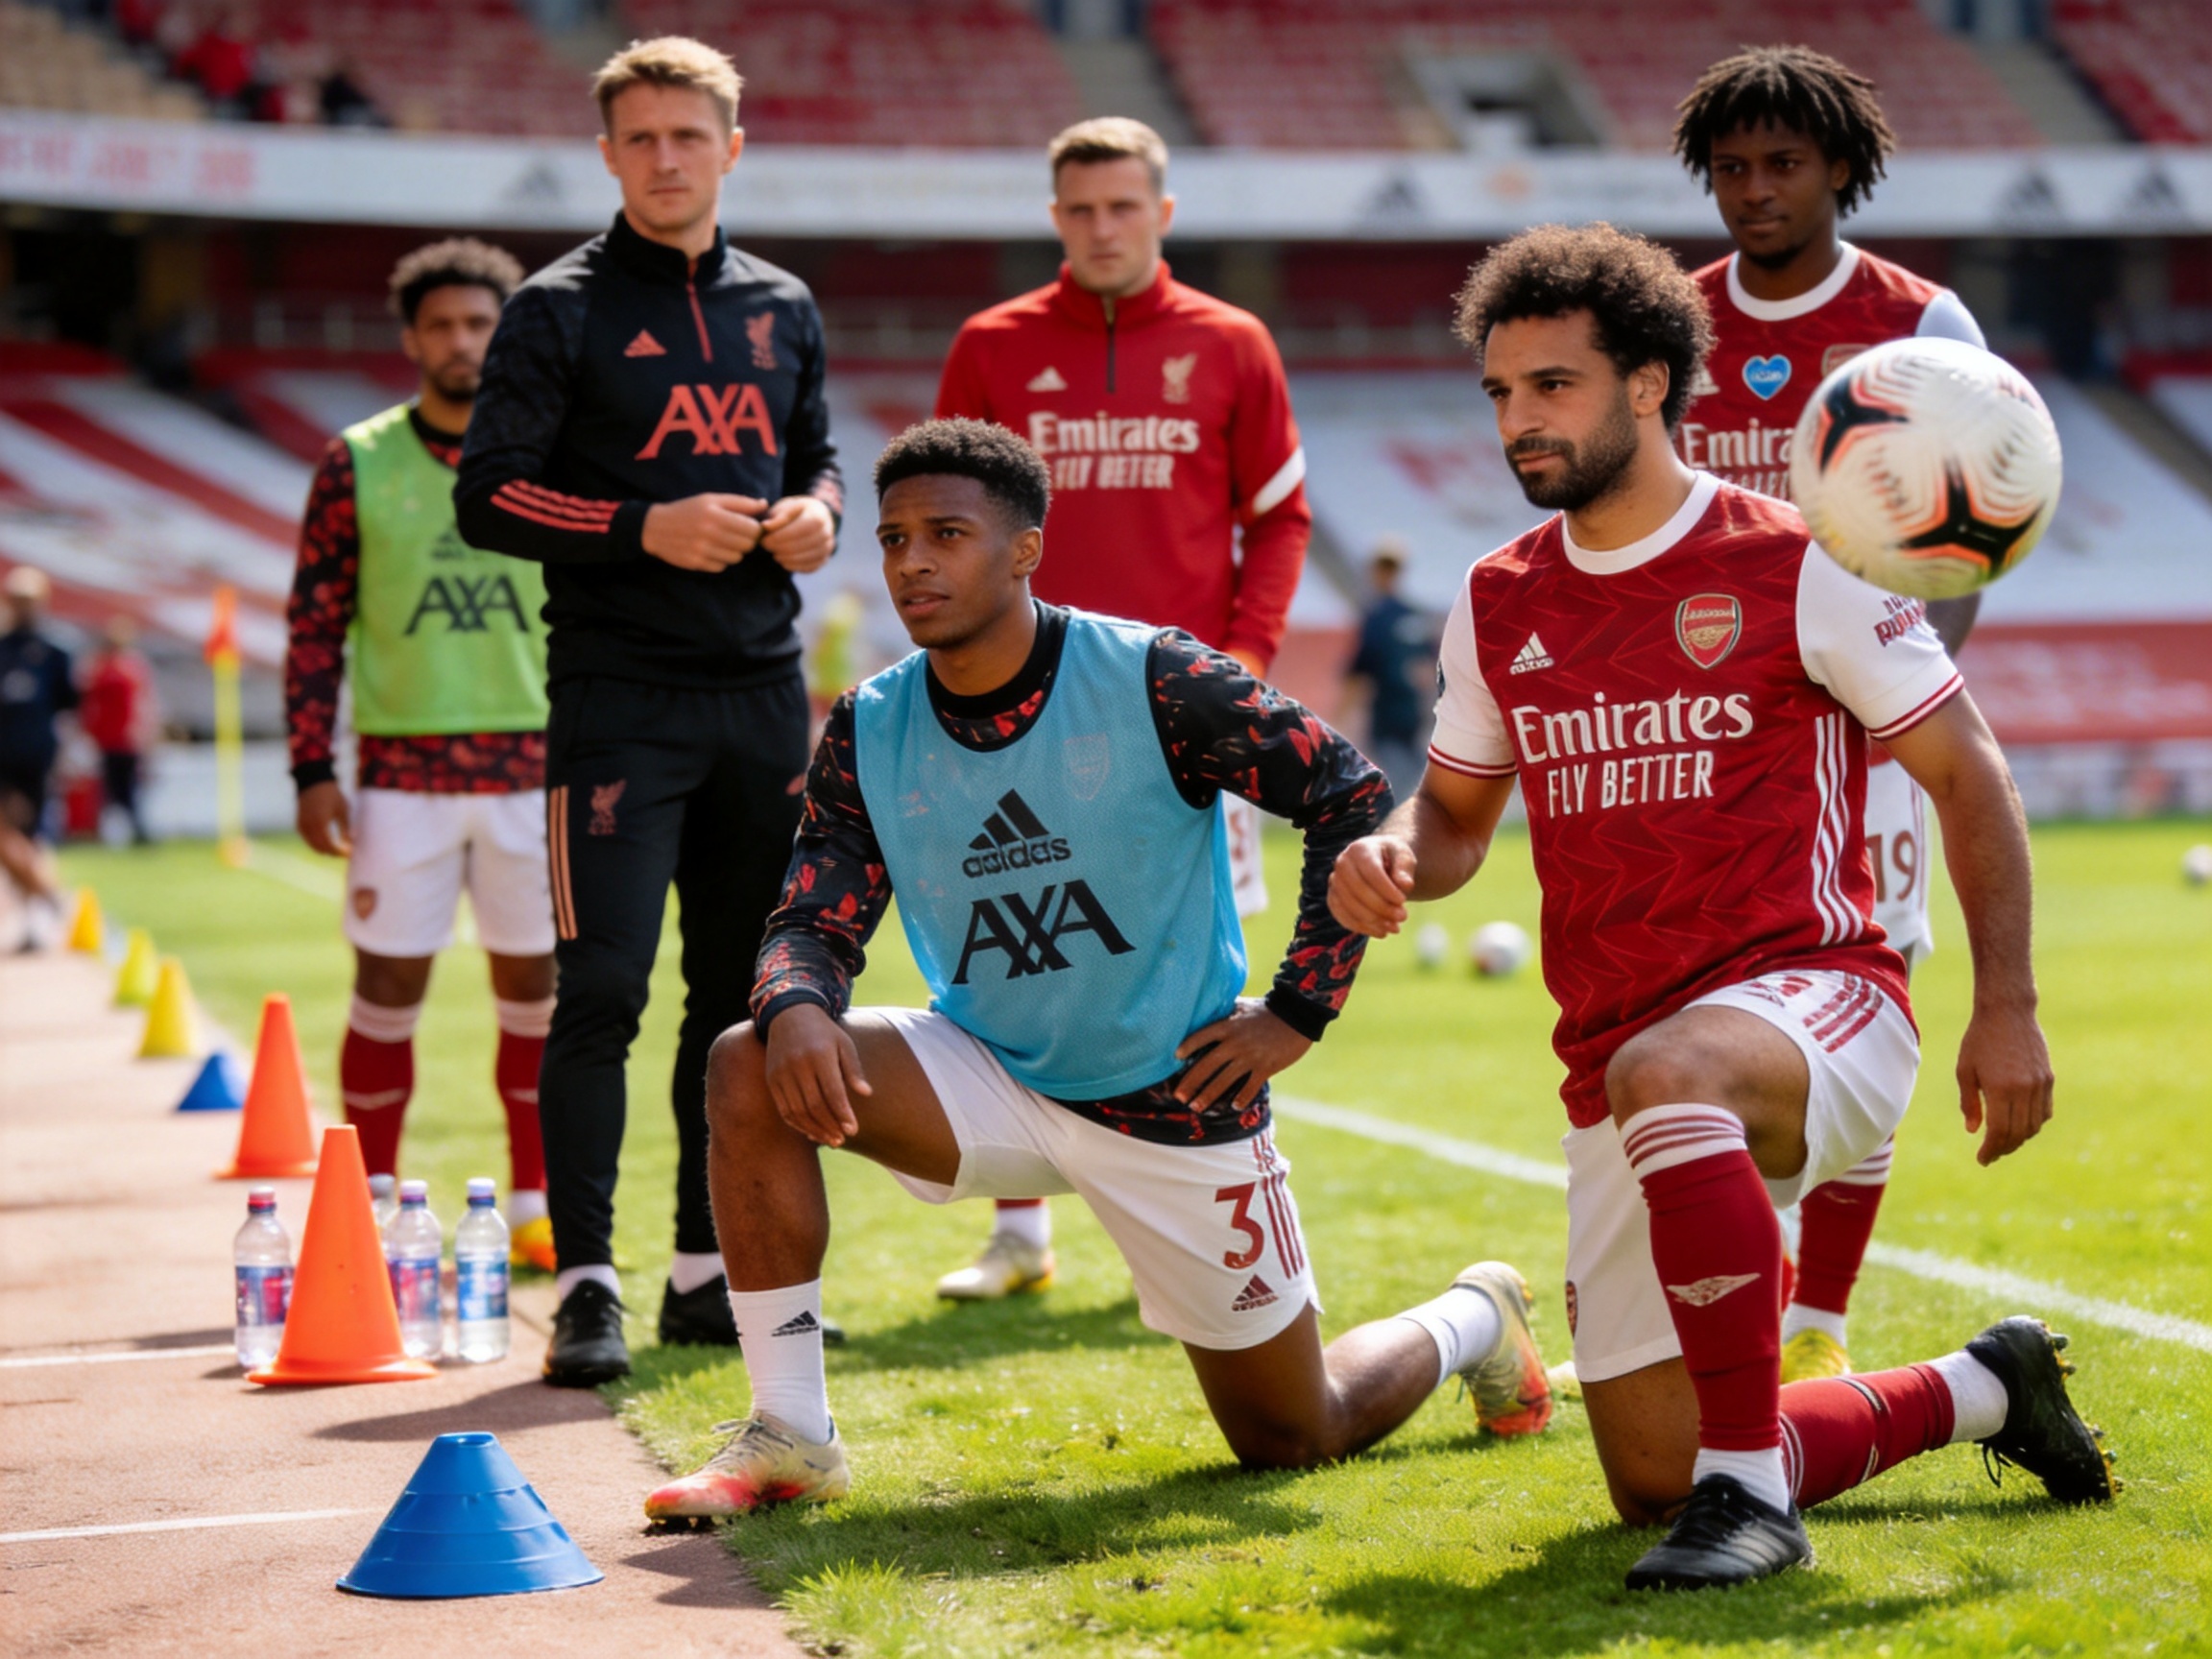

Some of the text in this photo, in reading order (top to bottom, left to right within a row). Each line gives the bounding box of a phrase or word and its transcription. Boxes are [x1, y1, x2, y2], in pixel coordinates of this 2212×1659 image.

[635, 383, 779, 461] AXA
[1027, 410, 1201, 453] Emirates
[403, 574, 531, 636] AXA
[1510, 687, 1754, 764] Emirates
[1547, 750, 1715, 819] FLY BETTER
[1864, 830, 1917, 903] 19
[950, 878, 1138, 985] AXA
[1214, 1181, 1265, 1270] 3
